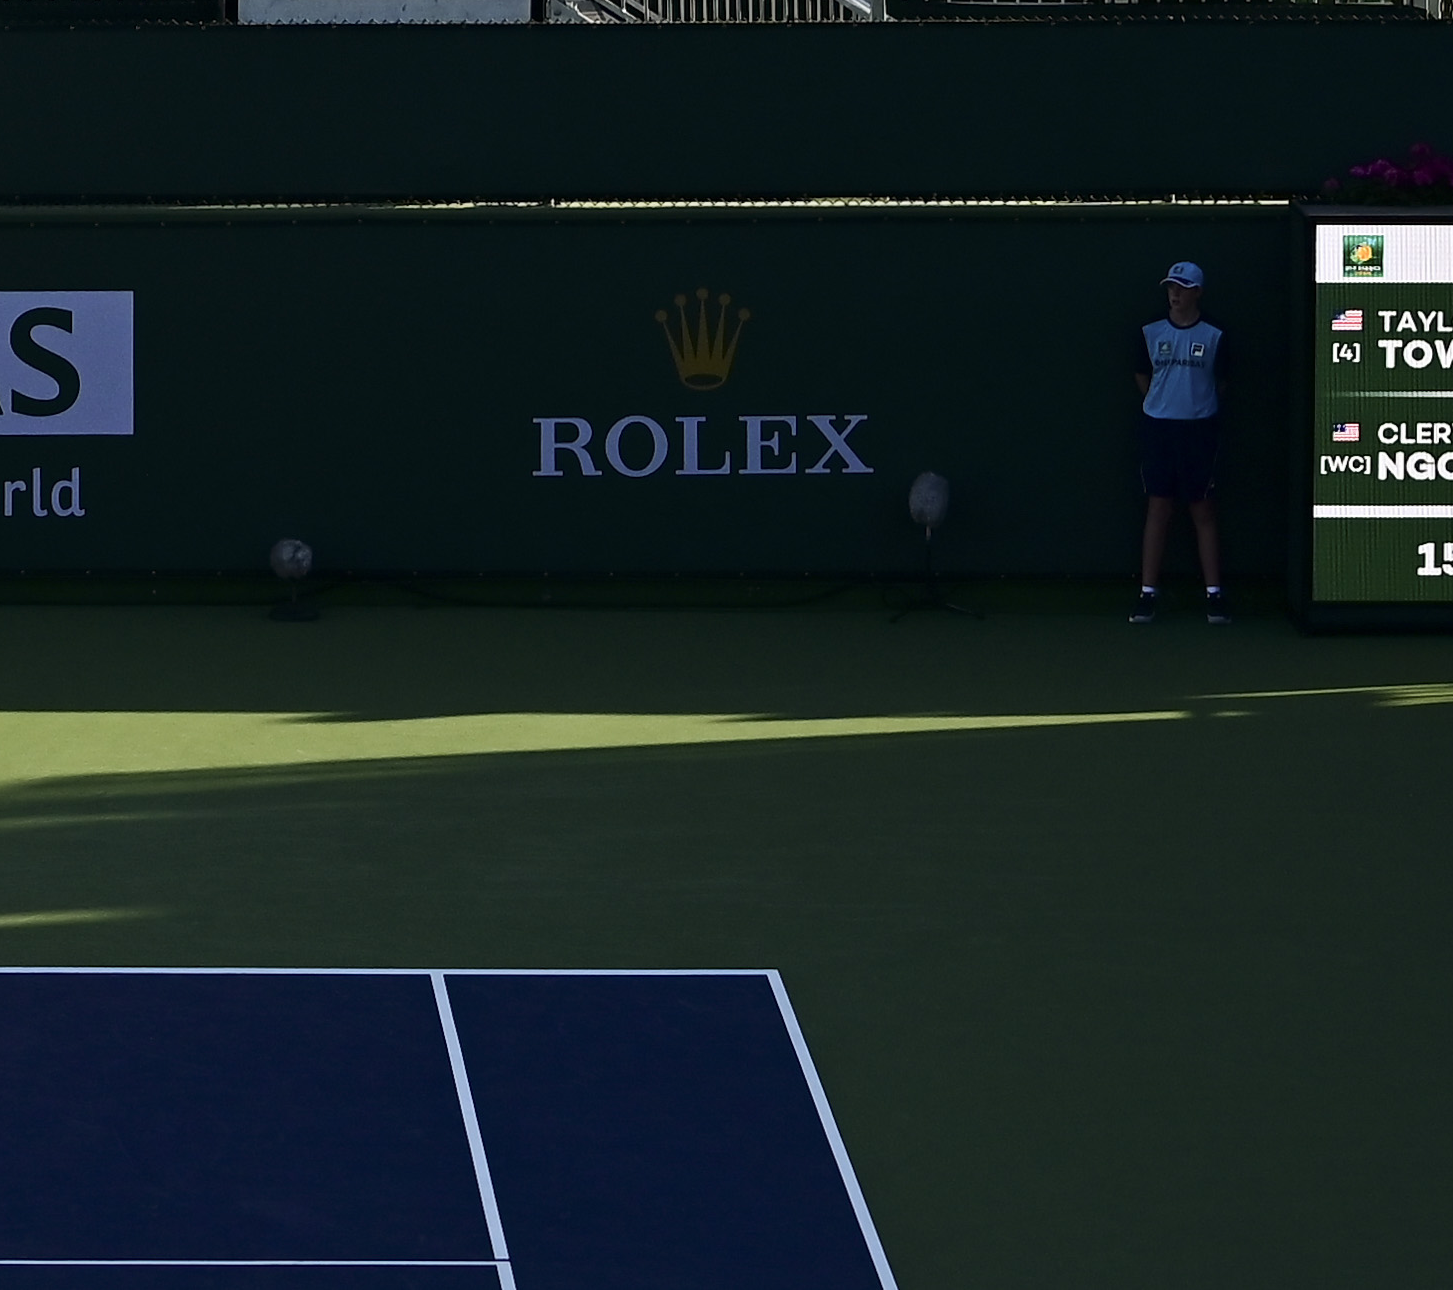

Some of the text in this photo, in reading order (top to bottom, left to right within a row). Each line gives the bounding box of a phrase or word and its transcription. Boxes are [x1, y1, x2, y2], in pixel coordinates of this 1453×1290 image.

[1332, 342, 1361, 363] [4]
[532, 414, 875, 478] ROLEX
[1320, 455, 1372, 475] [WC]
